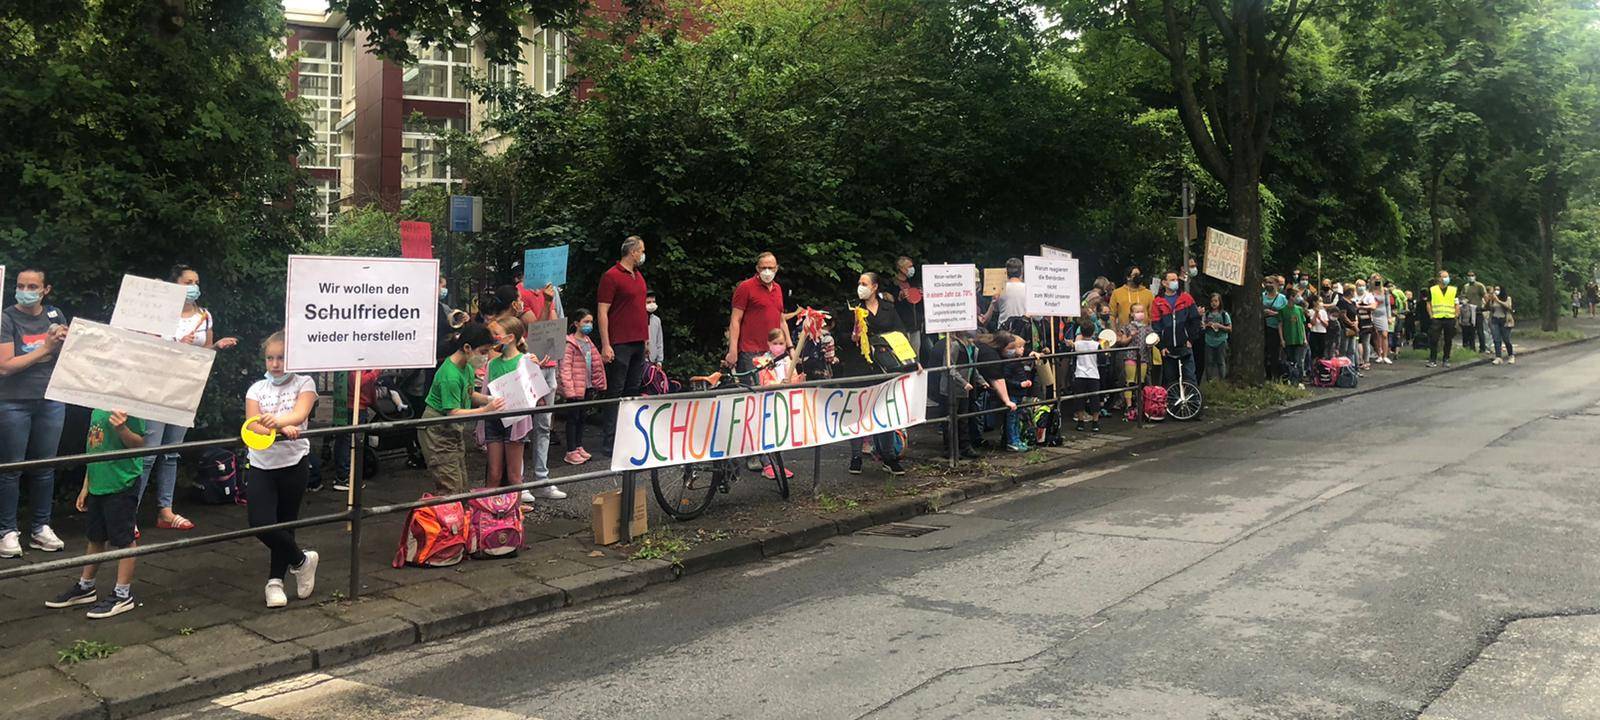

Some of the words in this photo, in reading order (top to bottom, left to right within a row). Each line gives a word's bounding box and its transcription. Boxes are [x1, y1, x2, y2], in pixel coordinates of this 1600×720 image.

[319, 282, 340, 294] Wir
[344, 284, 383, 294] wollen
[387, 284, 409, 294] den
[304, 304, 420, 320] Schulfrieden
[308, 331, 349, 342] wieder
[352, 330, 416, 341] herstellen!
[629, 387, 820, 466] SCHULFRIEDEN
